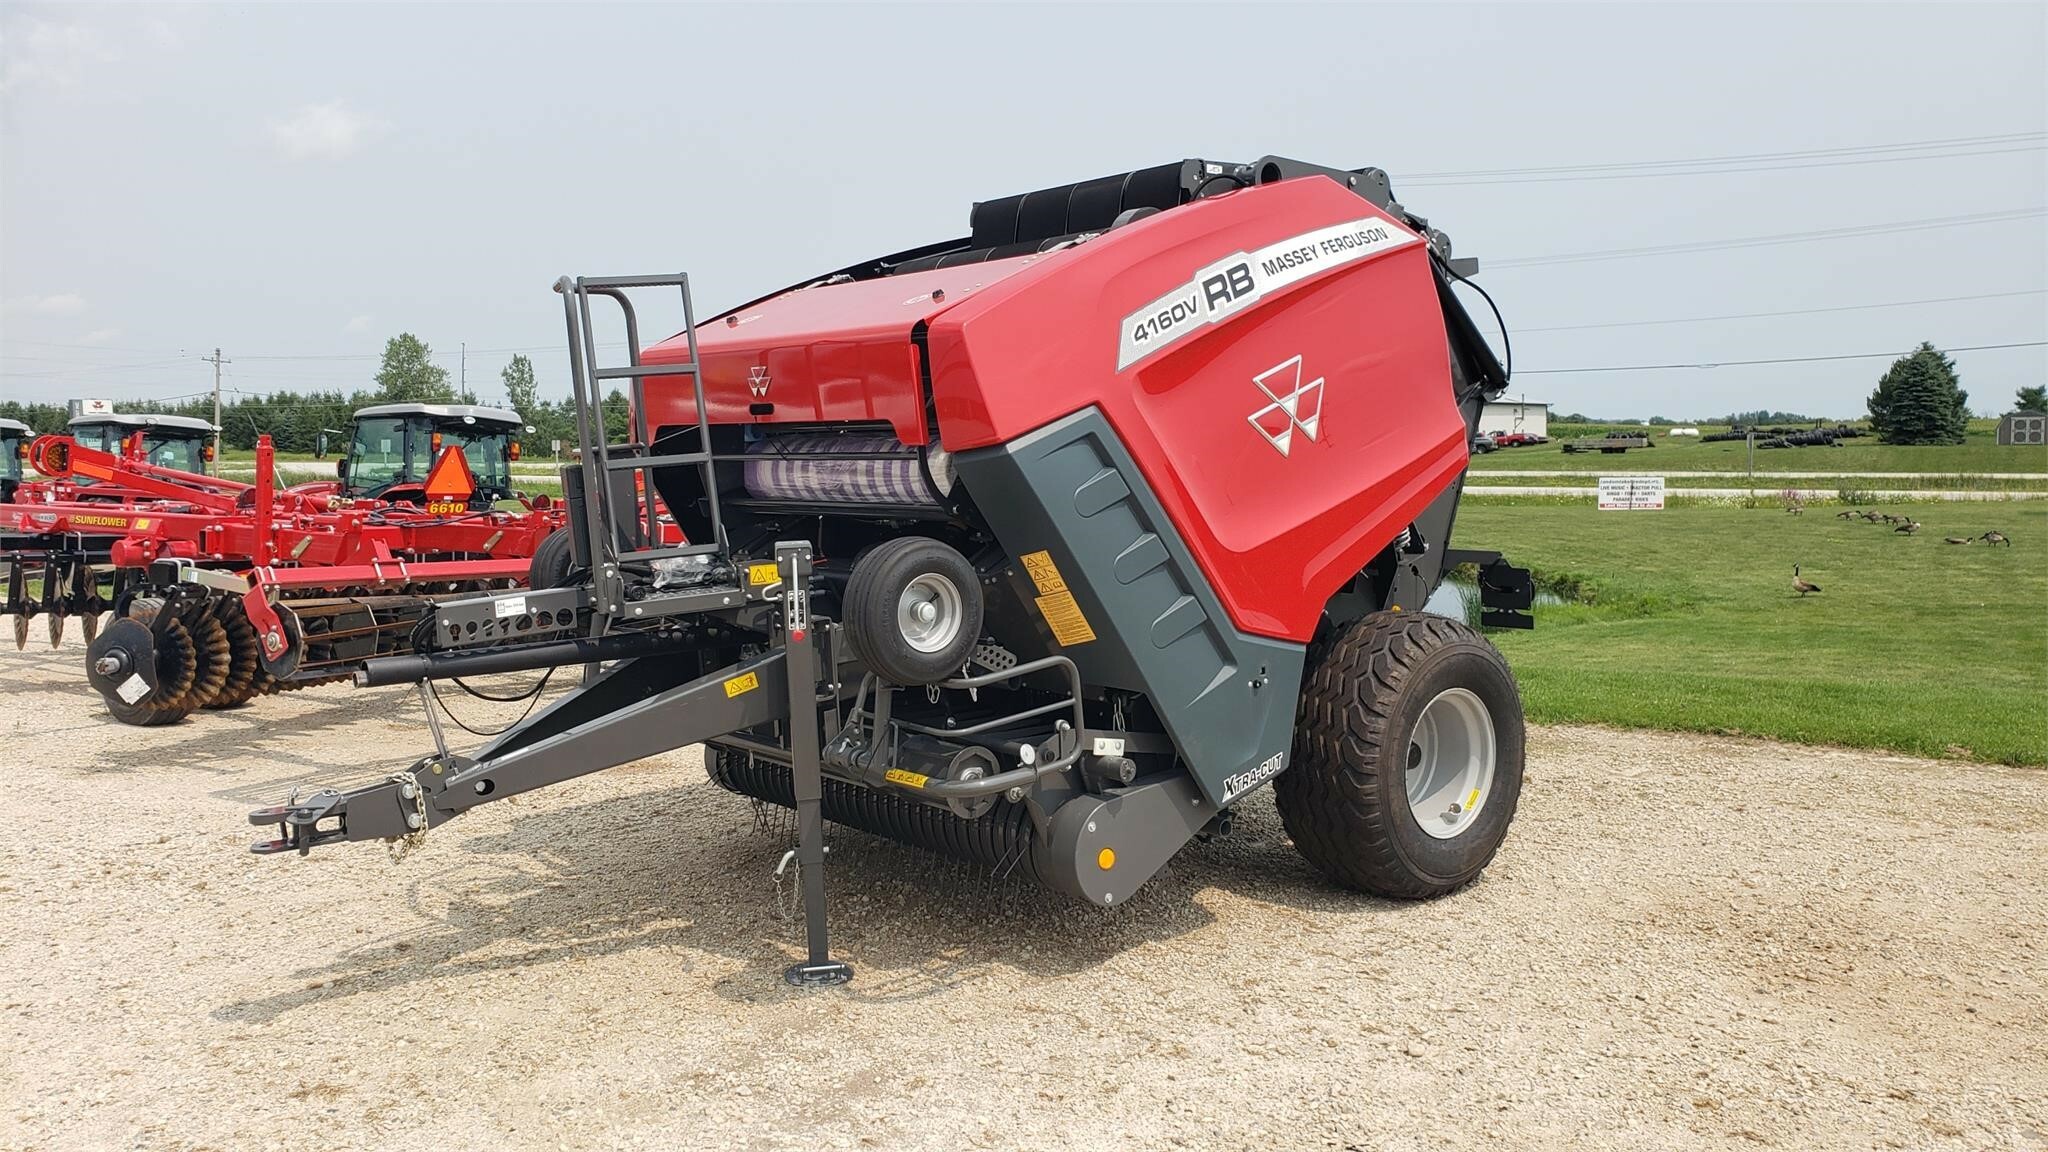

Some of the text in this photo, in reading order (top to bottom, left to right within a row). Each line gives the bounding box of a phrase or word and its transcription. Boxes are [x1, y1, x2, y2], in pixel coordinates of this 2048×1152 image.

[1133, 226, 1389, 342] 4160V RB MASSEY FERGUSON
[75, 515, 127, 526] SUNFLOWER
[429, 503, 464, 514] 6610
[1222, 752, 1283, 803] XTRA-CUT
